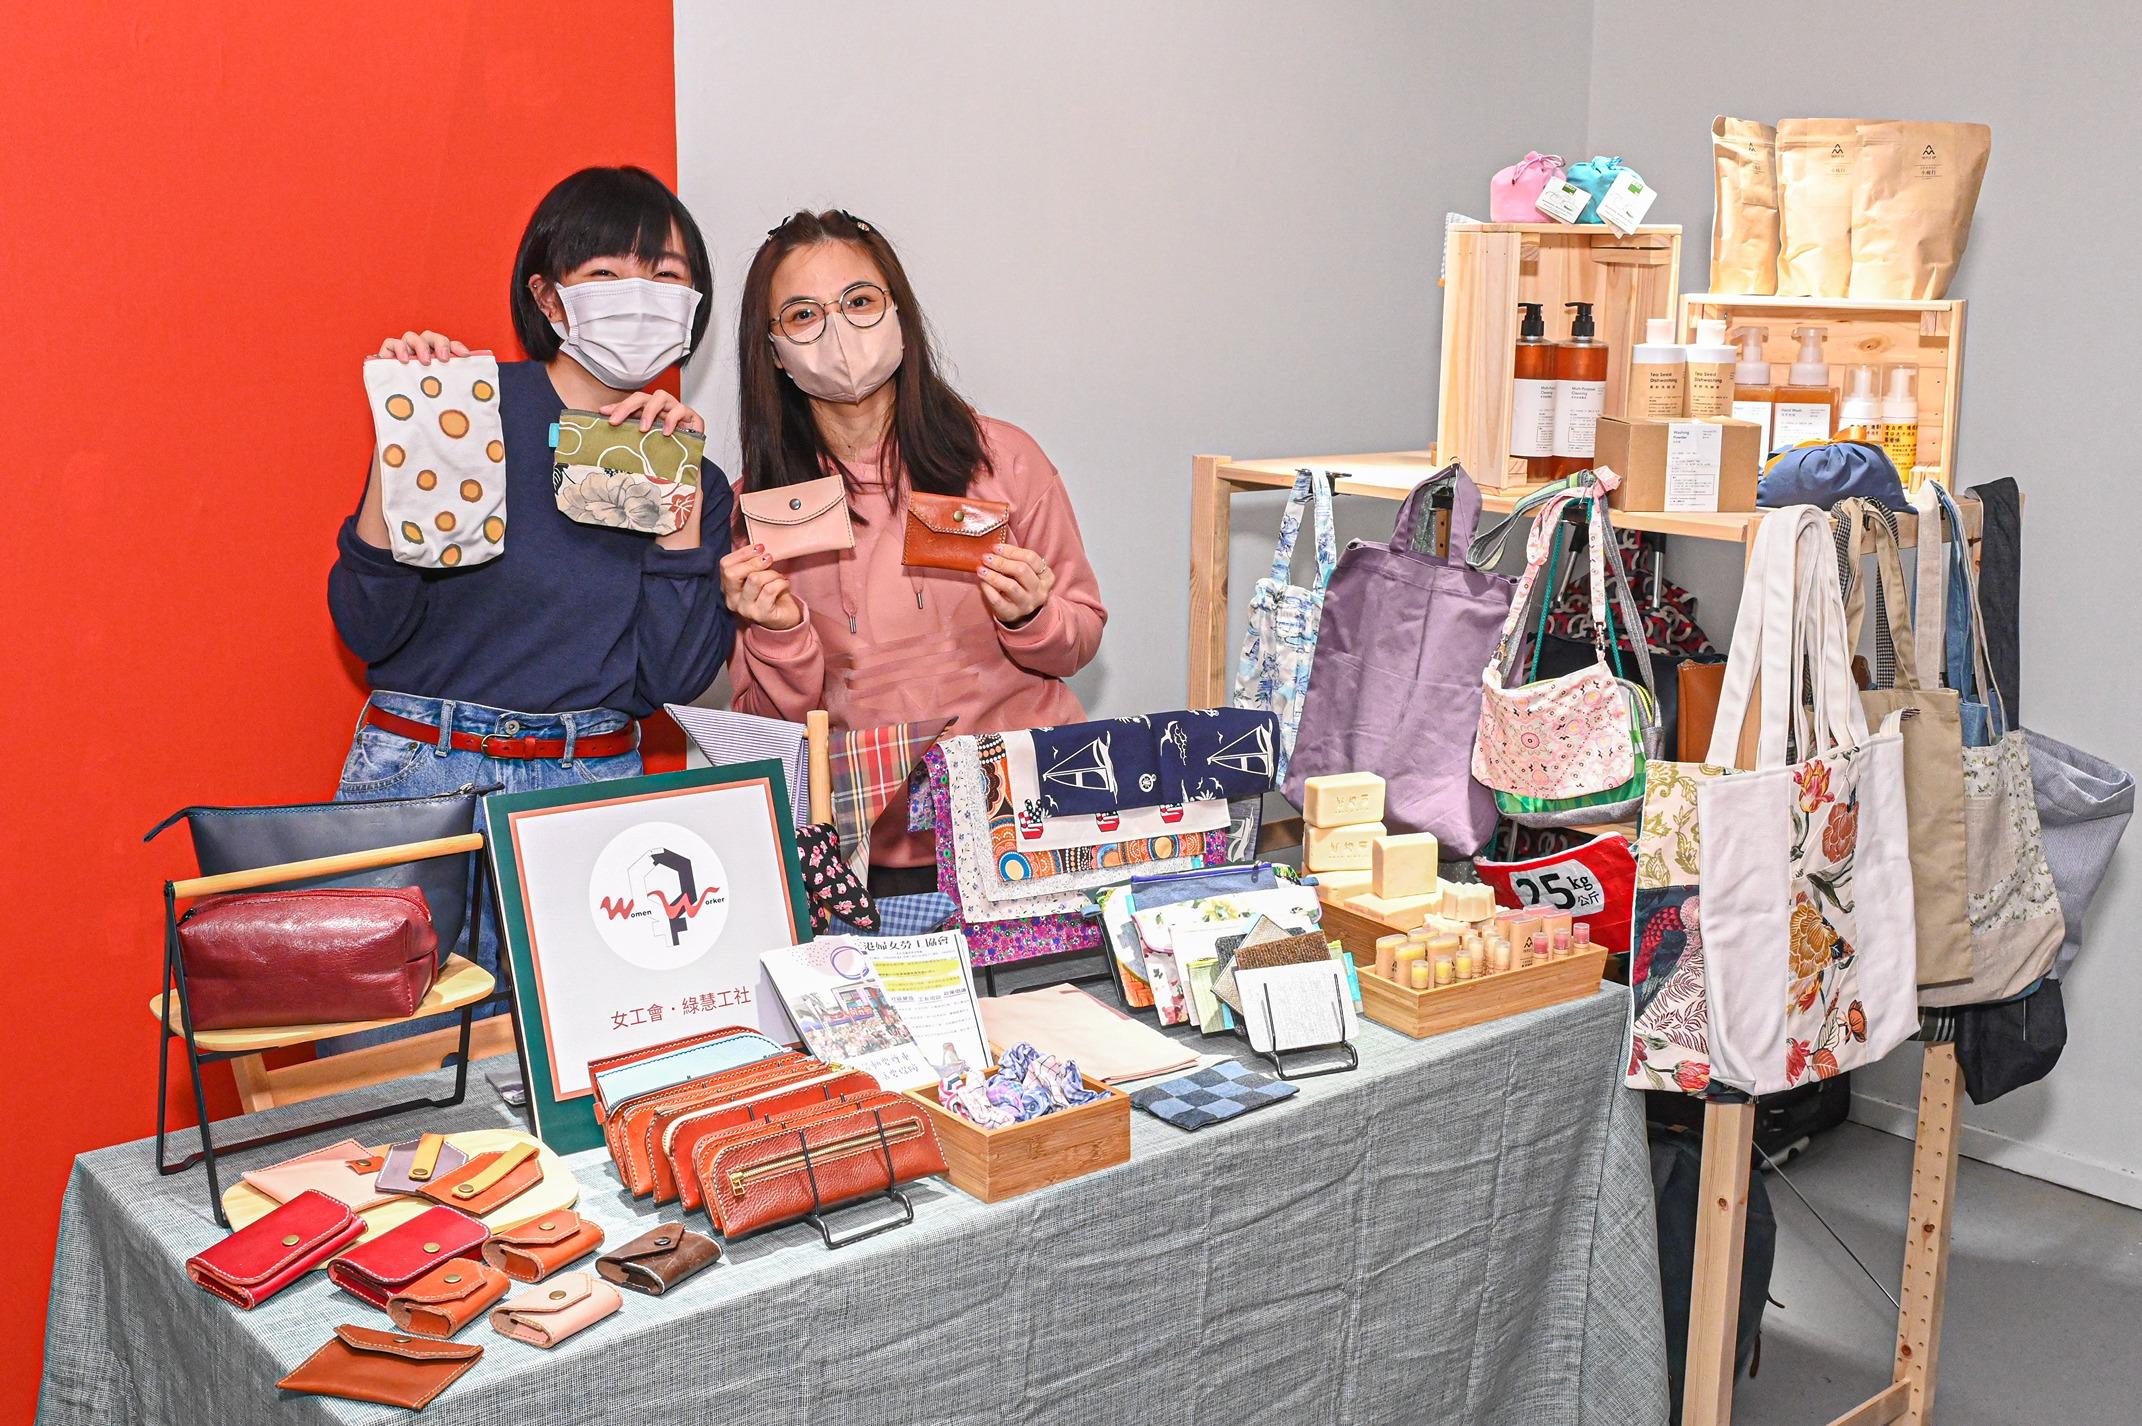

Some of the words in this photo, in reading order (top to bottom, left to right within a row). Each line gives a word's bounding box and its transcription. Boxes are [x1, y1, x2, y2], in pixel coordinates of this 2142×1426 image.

[600, 896, 652, 920] Women
[647, 886, 725, 919] Worker
[1515, 873, 1576, 910] 25
[1567, 876, 1594, 891] kg
[1578, 890, 1600, 907] 公斤
